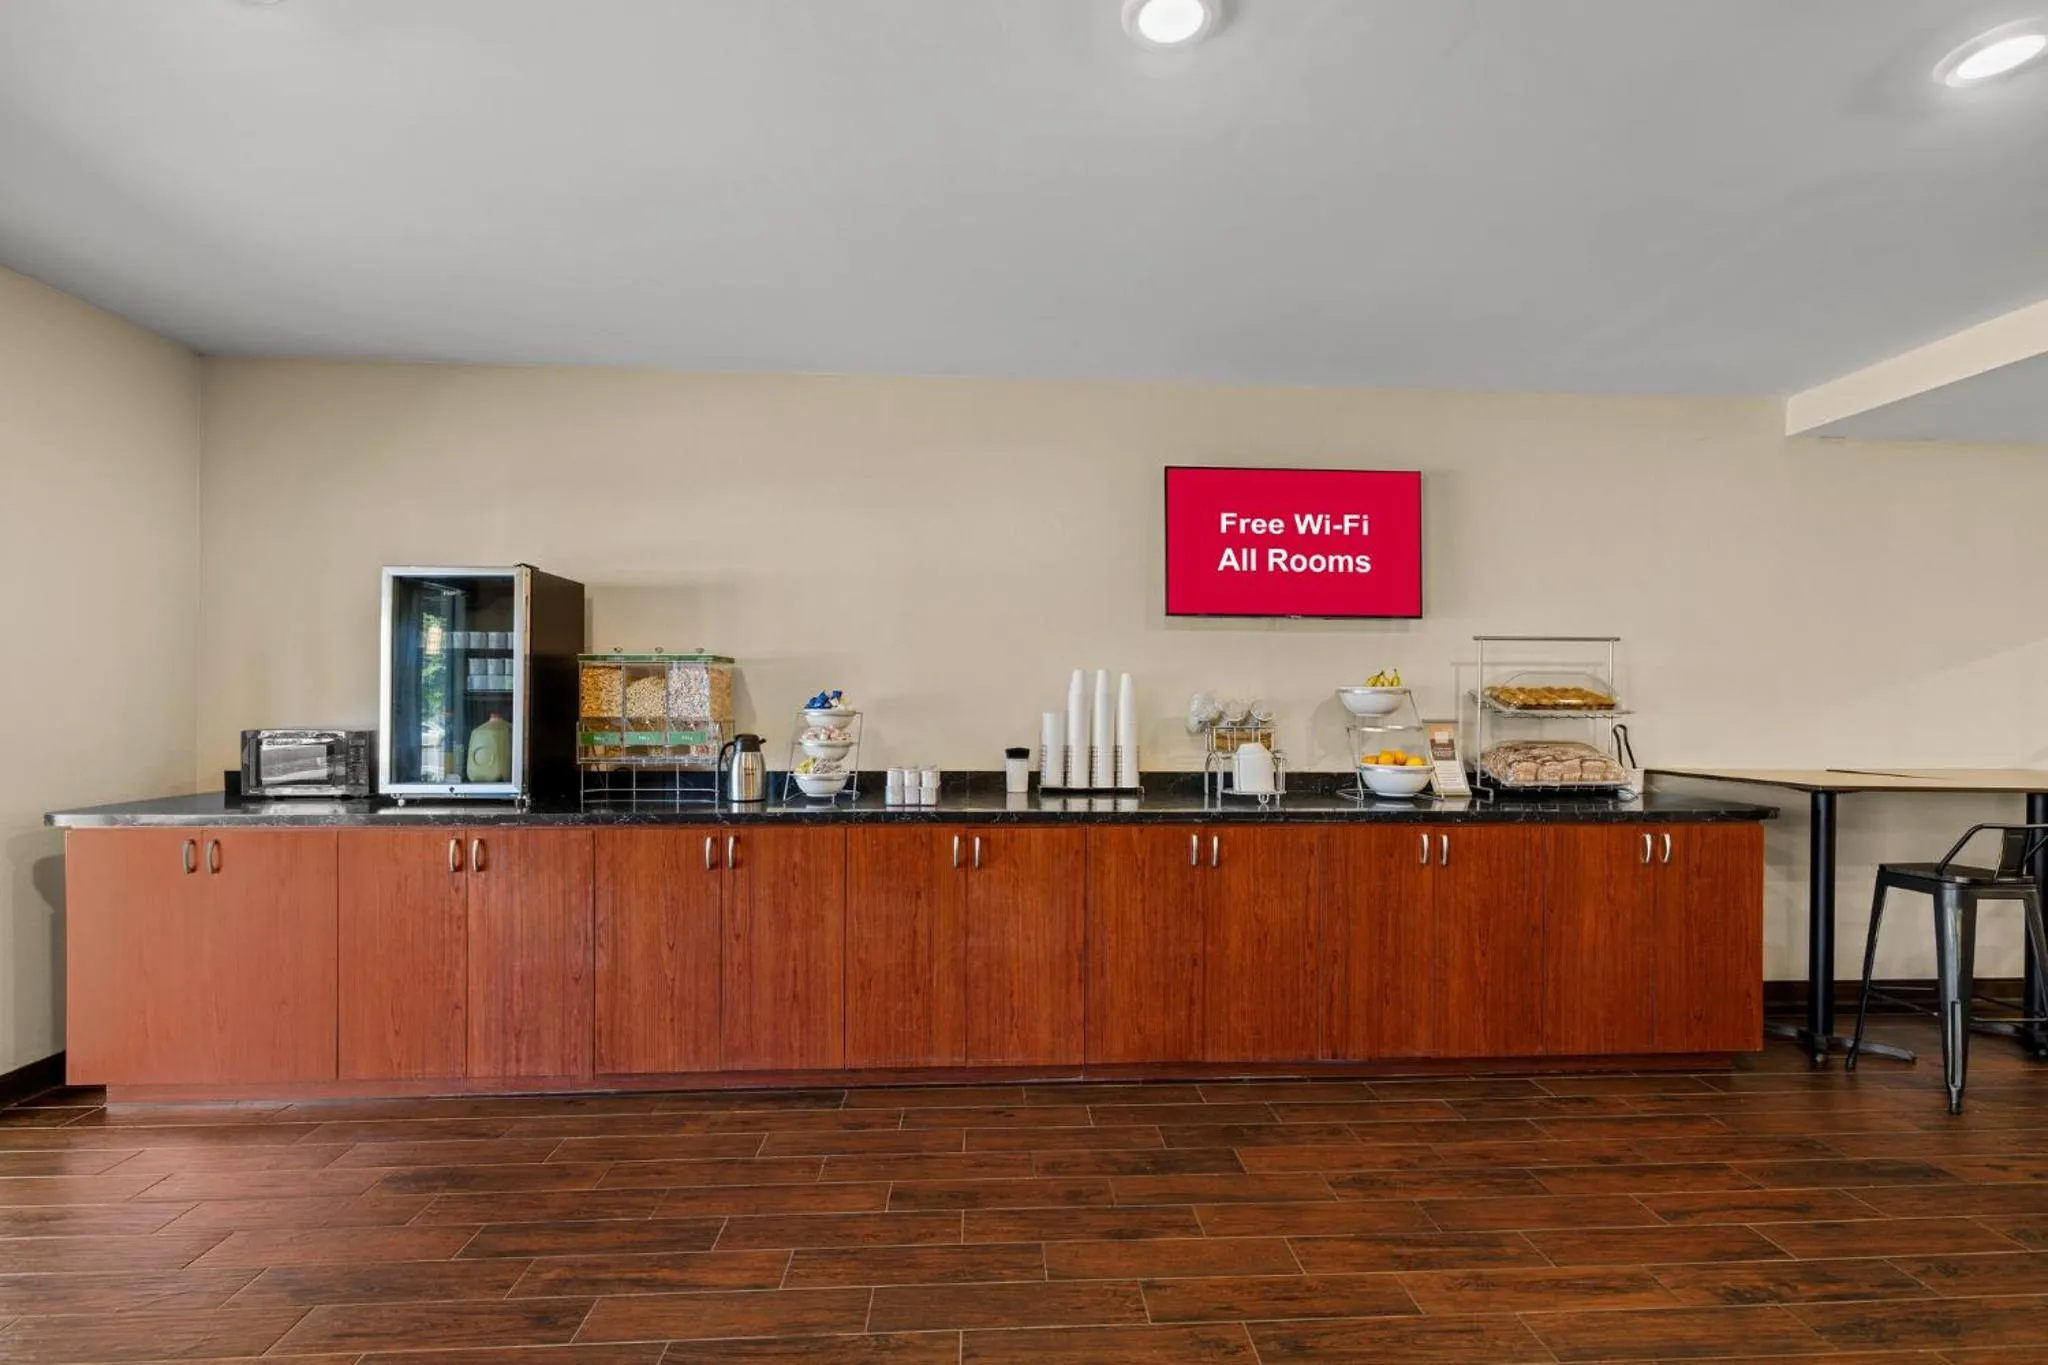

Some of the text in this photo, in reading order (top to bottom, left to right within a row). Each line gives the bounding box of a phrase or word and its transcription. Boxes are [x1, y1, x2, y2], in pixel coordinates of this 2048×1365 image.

[1220, 512, 1369, 536] Free Wi-Fi
[1217, 547, 1372, 573] All Rooms
